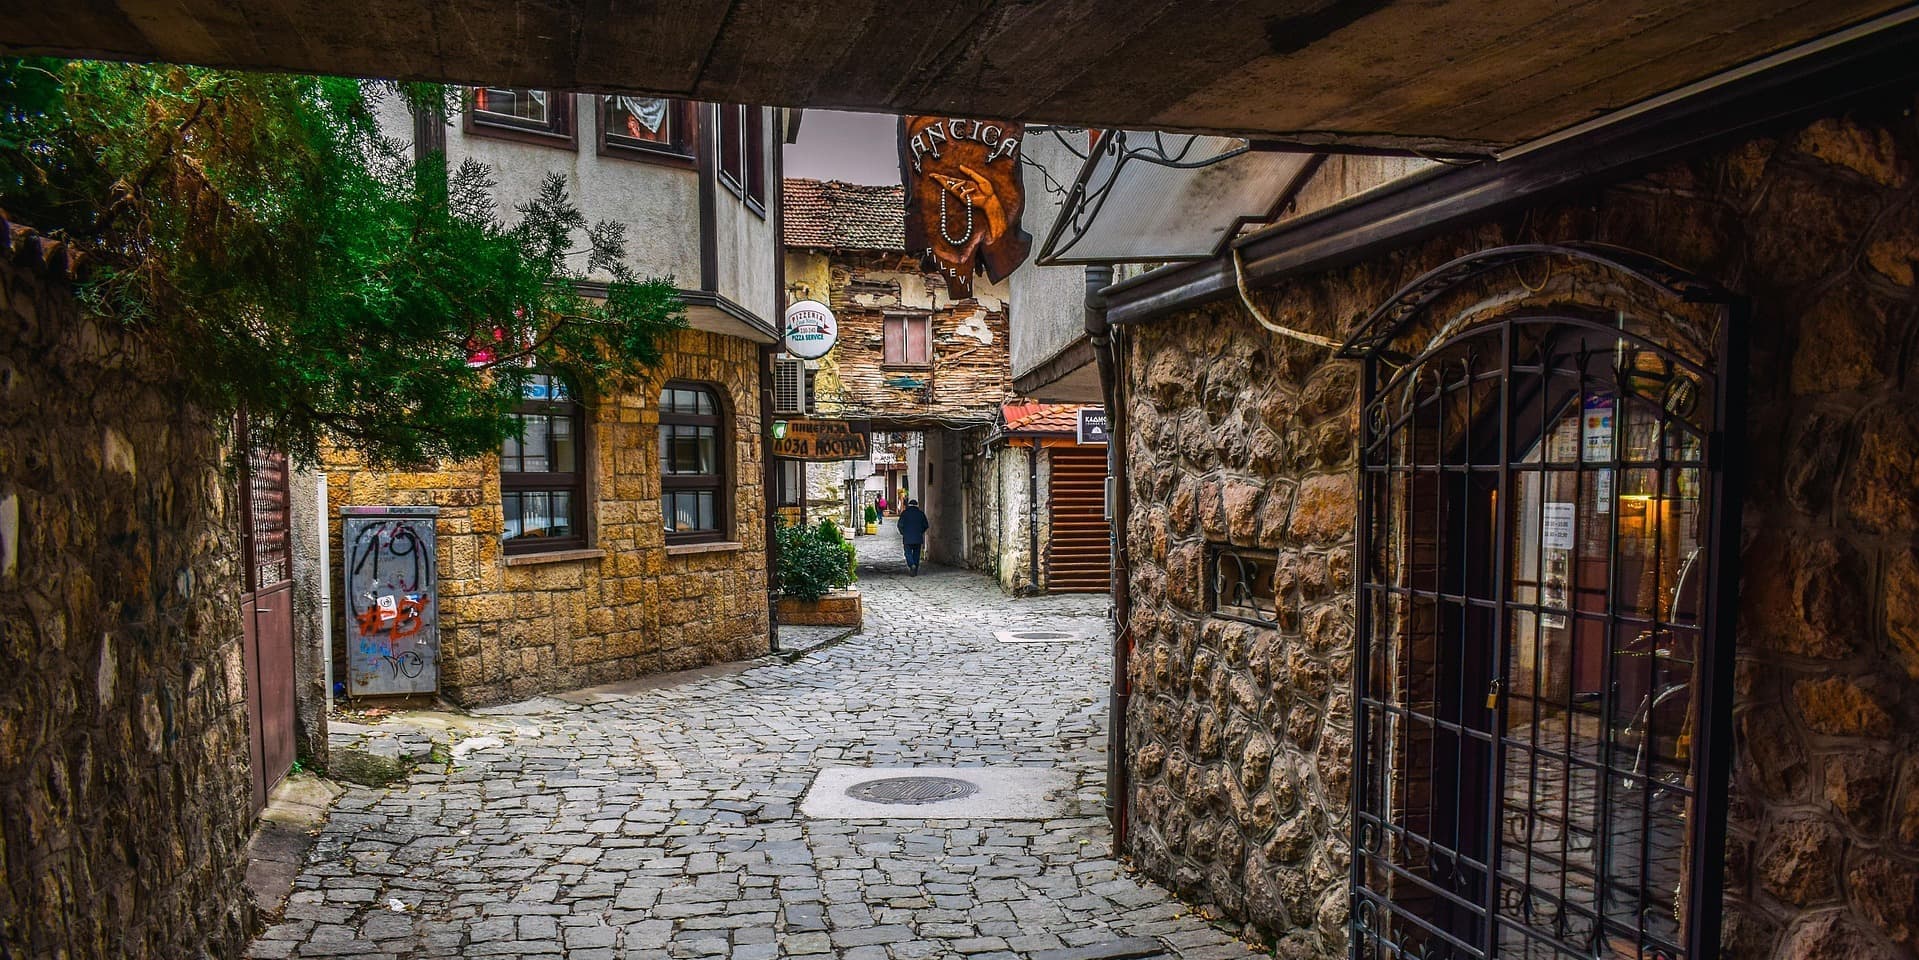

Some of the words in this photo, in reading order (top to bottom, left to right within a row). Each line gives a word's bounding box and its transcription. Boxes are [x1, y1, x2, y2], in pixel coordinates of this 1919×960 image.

[910, 119, 1019, 173] ANTICA
[926, 247, 971, 292] FILEVI
[792, 312, 822, 322] PIZZERIA
